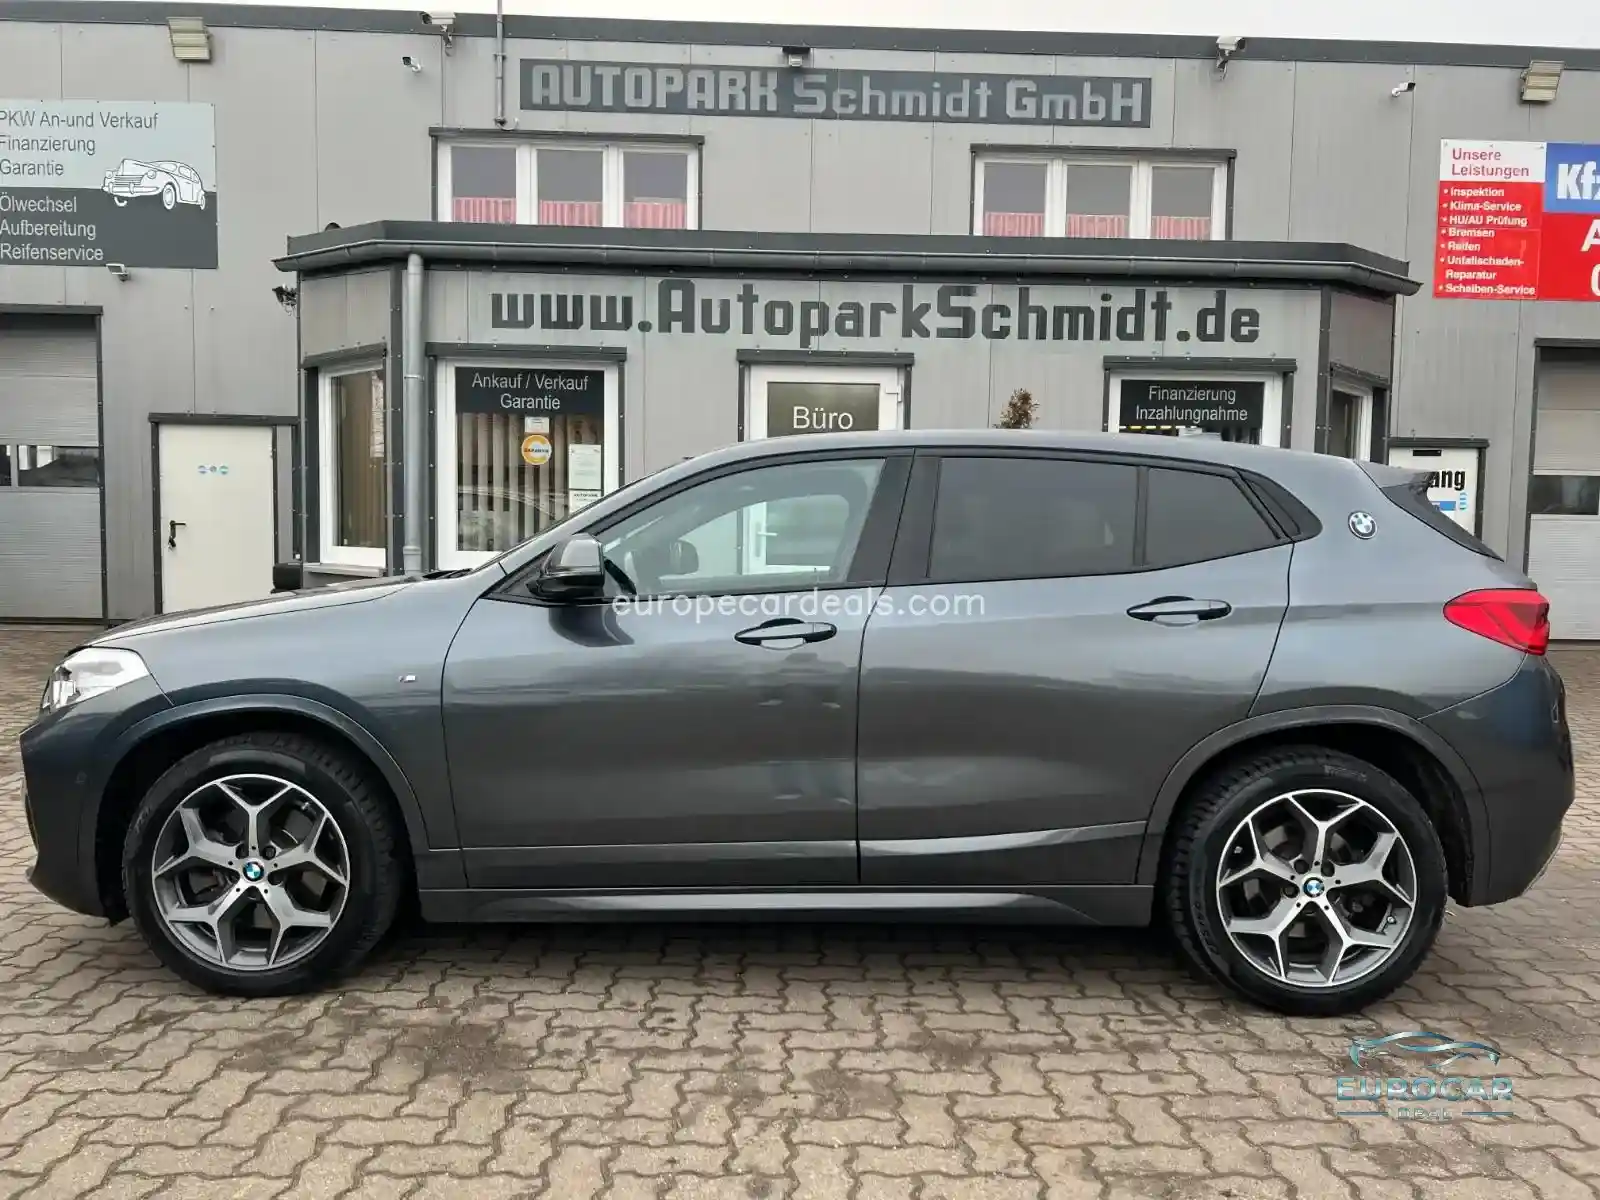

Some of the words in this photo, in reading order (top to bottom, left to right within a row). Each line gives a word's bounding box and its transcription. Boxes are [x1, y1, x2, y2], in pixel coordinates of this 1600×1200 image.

[531, 64, 778, 111] AUTOPARK
[793, 74, 992, 119] Schmidt
[1006, 79, 1144, 122] GmbH
[0, 110, 36, 127] PKW
[40, 111, 94, 128] An-und
[99, 112, 159, 129] Verkauf
[0, 134, 96, 156] Finanzierung
[1452, 148, 1502, 161] Unsere
[0, 159, 64, 176] Garantie
[1451, 164, 1530, 179] Leistungen
[1450, 187, 1505, 198] Inspektion
[0, 192, 77, 213] Ölwechsel
[1449, 202, 1522, 212] Klima-Service
[0, 219, 96, 240] Aufbereitung
[1449, 215, 1483, 225] HU/AU
[1486, 216, 1528, 228] Prüfung
[1448, 228, 1495, 238] Bremsen
[0, 243, 104, 261] Reifenservice
[1447, 241, 1481, 252] Reifen
[1445, 269, 1497, 281] Reparatur
[1445, 284, 1536, 295] Scheiben-Service
[491, 278, 1260, 350] www.AutoparkSchmidt.de
[471, 373, 522, 388] Ankauf
[535, 374, 589, 391] Verkauf
[500, 393, 561, 410] Garantie
[1149, 385, 1236, 404] Finanzierung
[793, 406, 853, 430] Büro
[1136, 405, 1248, 424] Inzahlungnahme
